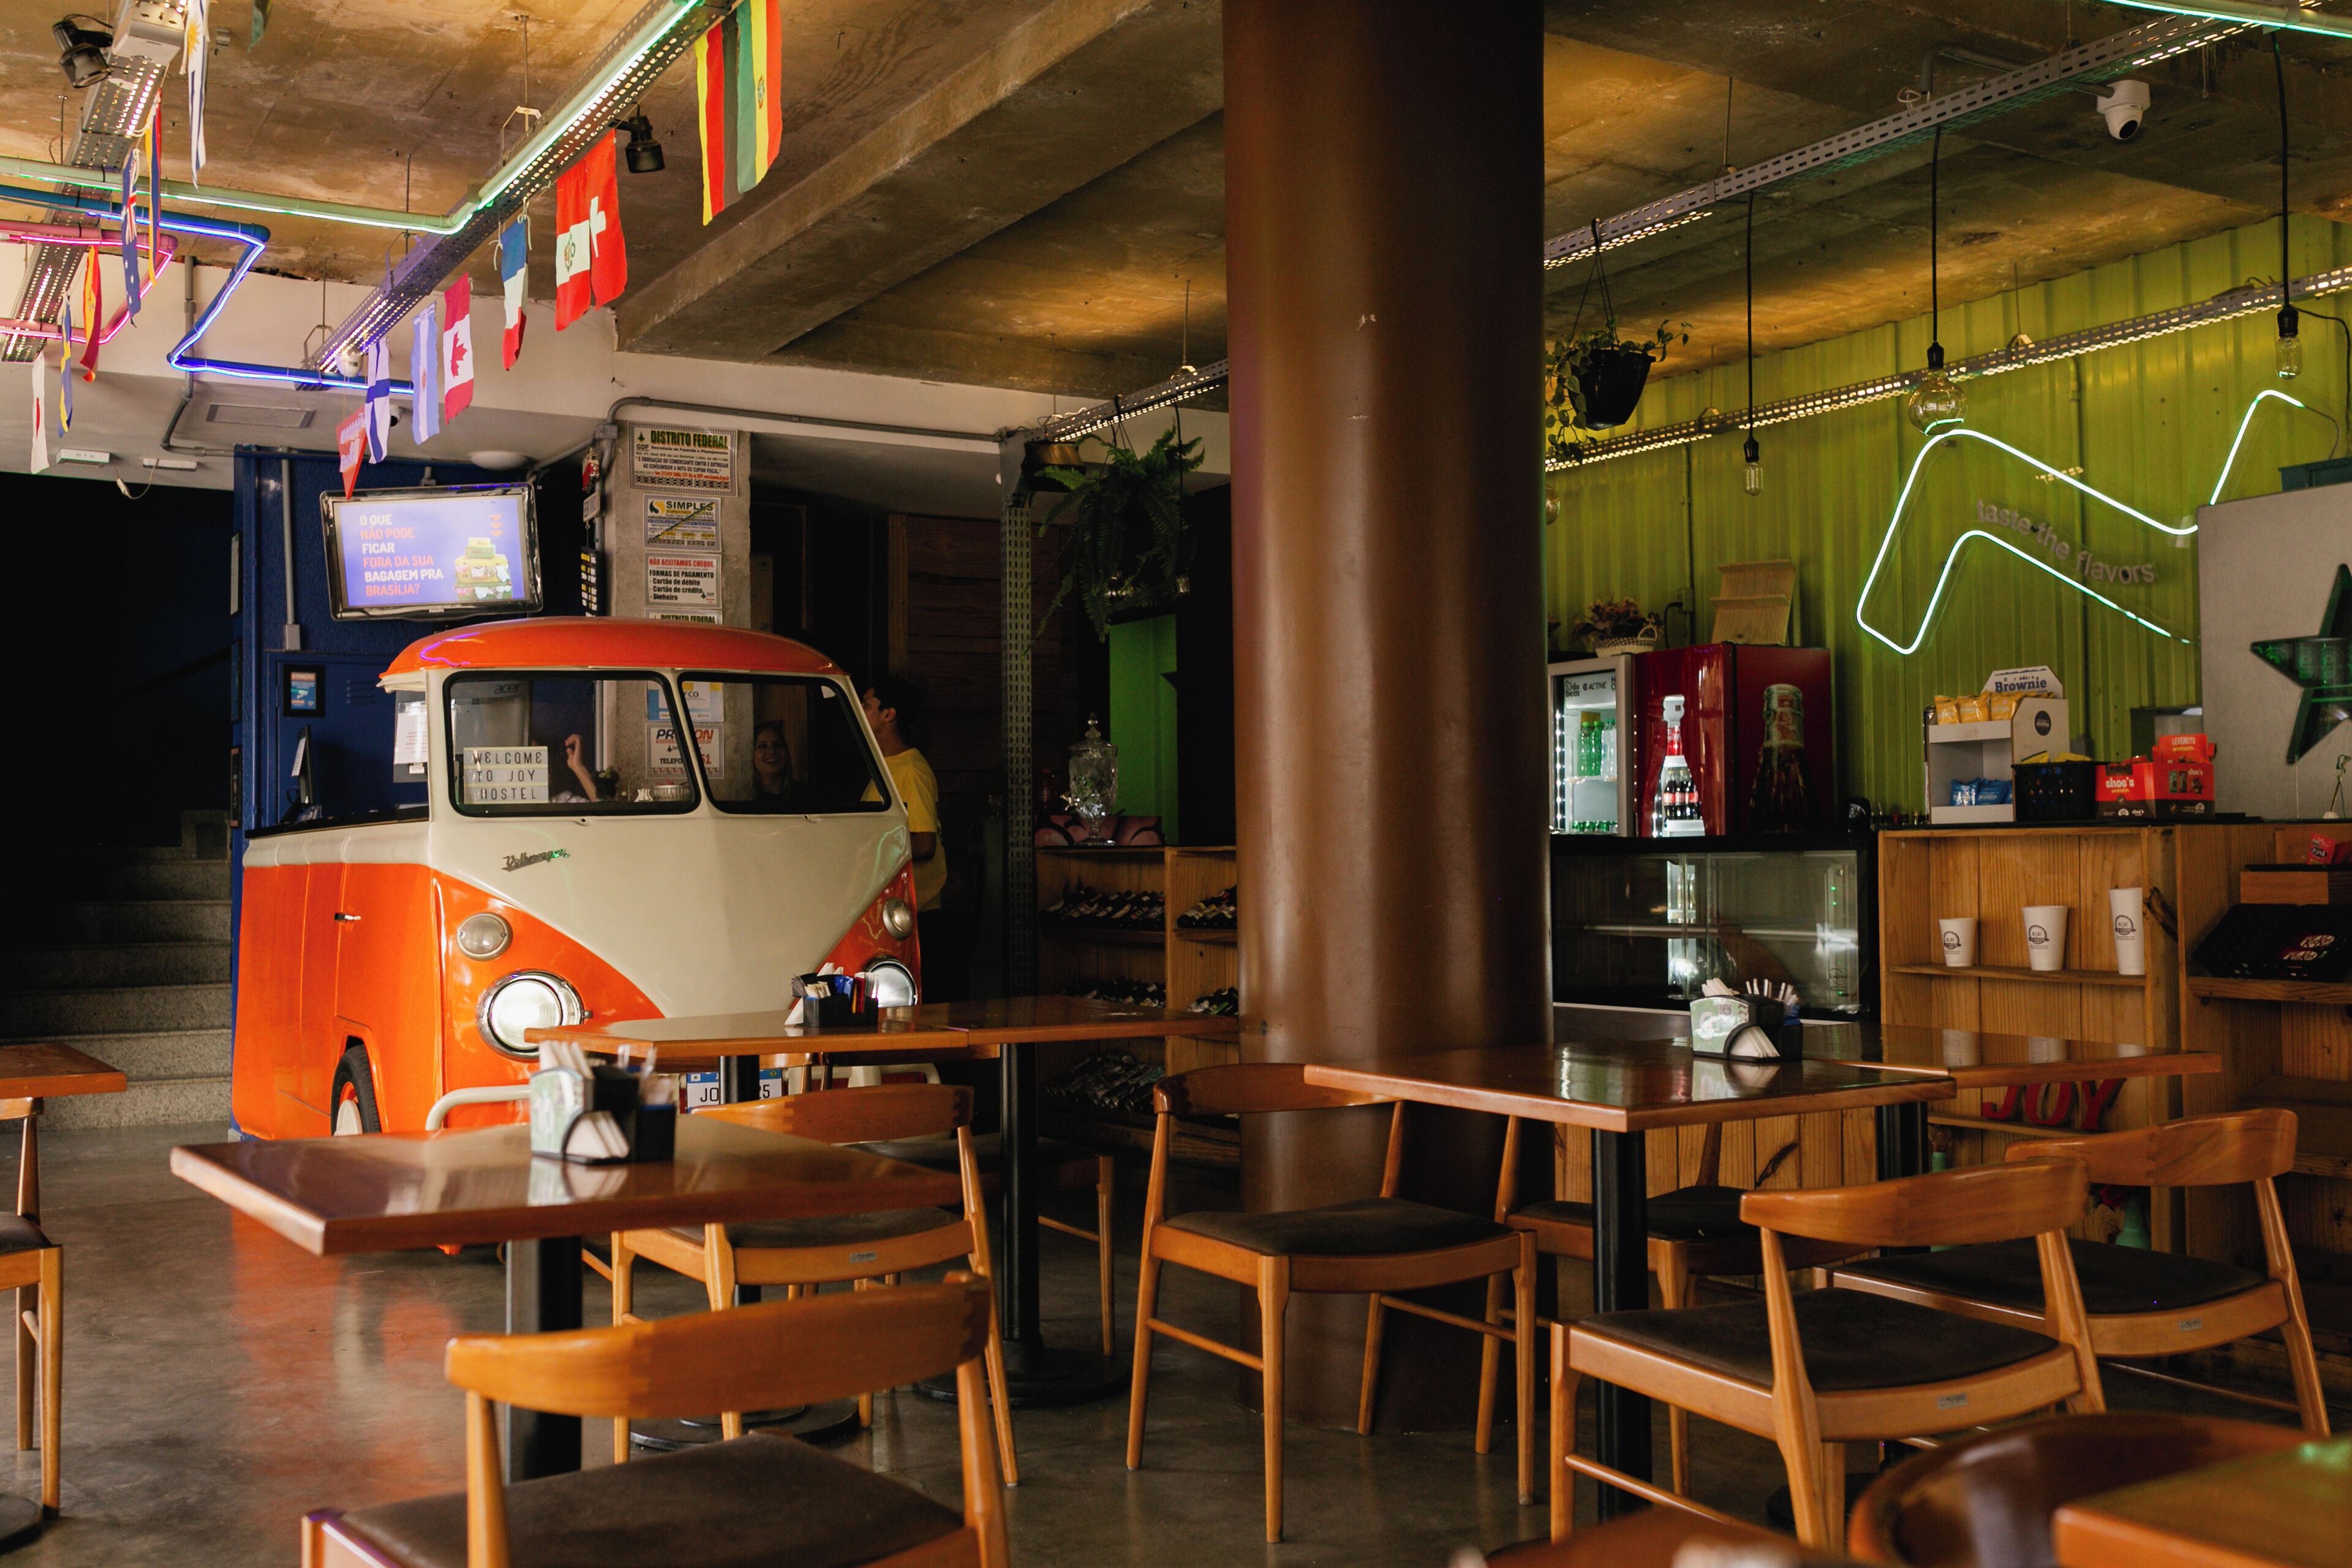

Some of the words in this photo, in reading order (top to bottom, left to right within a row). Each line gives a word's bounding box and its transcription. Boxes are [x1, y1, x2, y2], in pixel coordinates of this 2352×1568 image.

[650, 430, 692, 446] DISTRITO
[693, 434, 728, 450] FEDERAL
[641, 456, 663, 464] OBRIGAÇÃO
[666, 500, 714, 511] SIMPLES
[360, 515, 367, 526] O
[370, 514, 393, 527] QUE
[360, 527, 383, 540] NÃO
[386, 527, 416, 539] PODE
[362, 542, 395, 554] FICAR
[1976, 499, 2032, 535] taste
[2036, 522, 2070, 560] the
[2076, 550, 2156, 584] flavors
[363, 556, 393, 568] FORA
[394, 556, 410, 567] DA
[412, 554, 434, 567] SUA
[662, 559, 692, 567] ACEITAMOS
[364, 569, 418, 582] BAGAGEM
[420, 568, 444, 580] PRA
[366, 582, 420, 597] BRASÍLIA?
[494, 683, 523, 694] acer
[1588, 681, 1607, 690] ACTIVE
[1994, 677, 2047, 693] Brownie
[473, 751, 542, 764] WELCOME
[477, 769, 493, 782] TO
[509, 769, 535, 782] JOY
[2105, 777, 2135, 789] choc's
[480, 788, 537, 800] HOSTEL
[1982, 1079, 2119, 1131] JOY
